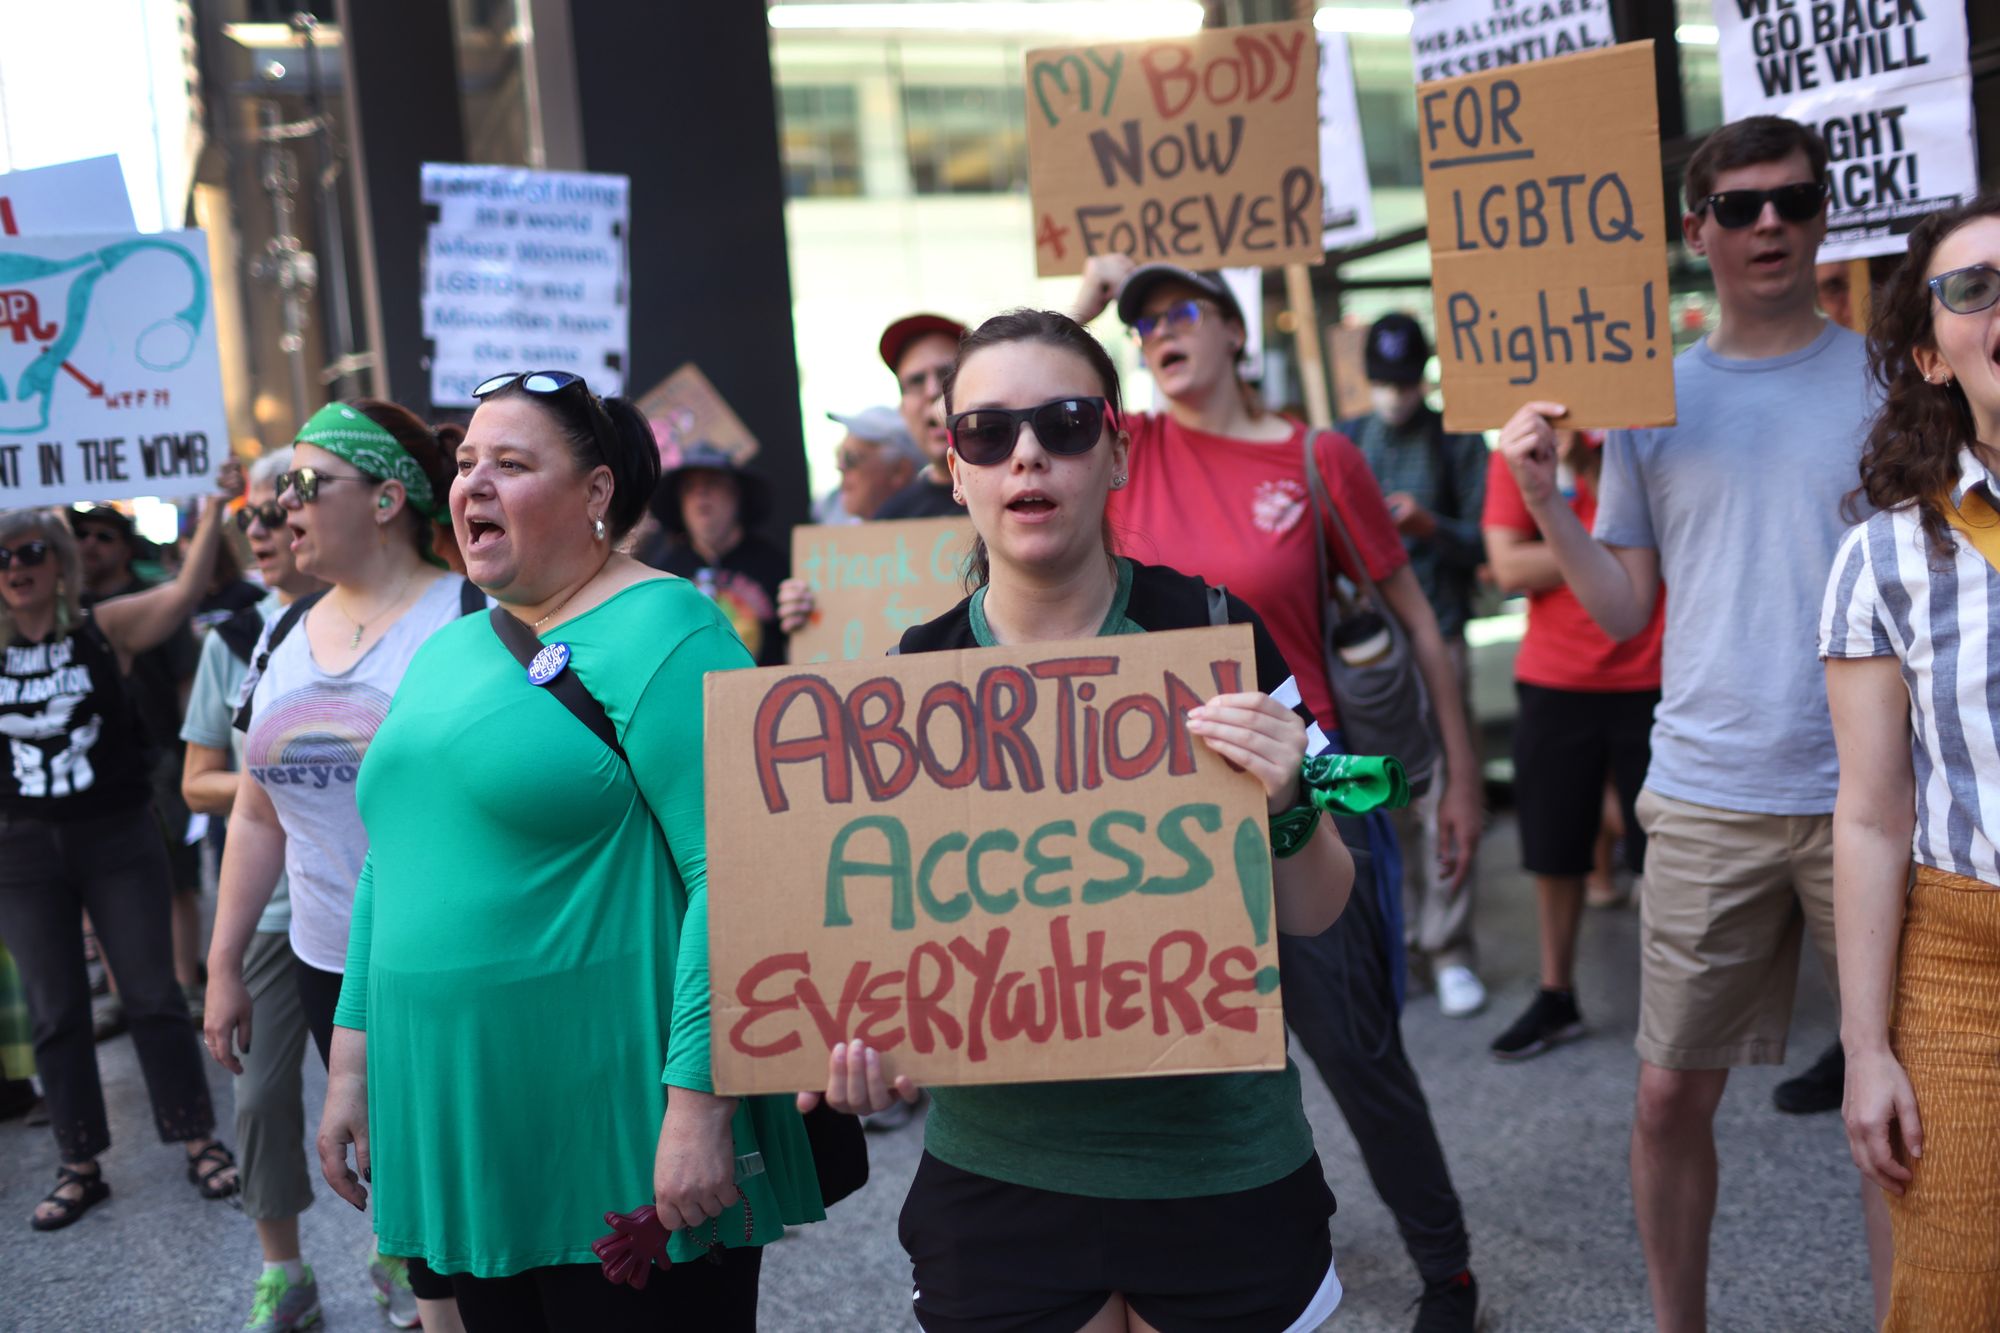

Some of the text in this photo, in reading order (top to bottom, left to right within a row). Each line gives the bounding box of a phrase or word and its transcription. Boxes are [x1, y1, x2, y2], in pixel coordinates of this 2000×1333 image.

[1753, 0, 1926, 57] GO BACK
[1757, 27, 1929, 98] WE WILL
[1032, 30, 1304, 128] MY BODY
[1423, 79, 1523, 151] FOR
[1808, 105, 1907, 163] GHT
[1089, 115, 1244, 188] NOW
[1075, 166, 1314, 257] FOREVER
[1453, 172, 1644, 250] LGBTQ
[1448, 280, 1656, 385] Rights!
[38, 441, 65, 487] IN
[77, 437, 129, 483] THE
[139, 431, 209, 480] WOMB
[803, 533, 920, 593] thank
[533, 643, 556, 665] KEEP
[251, 764, 357, 789] veryo
